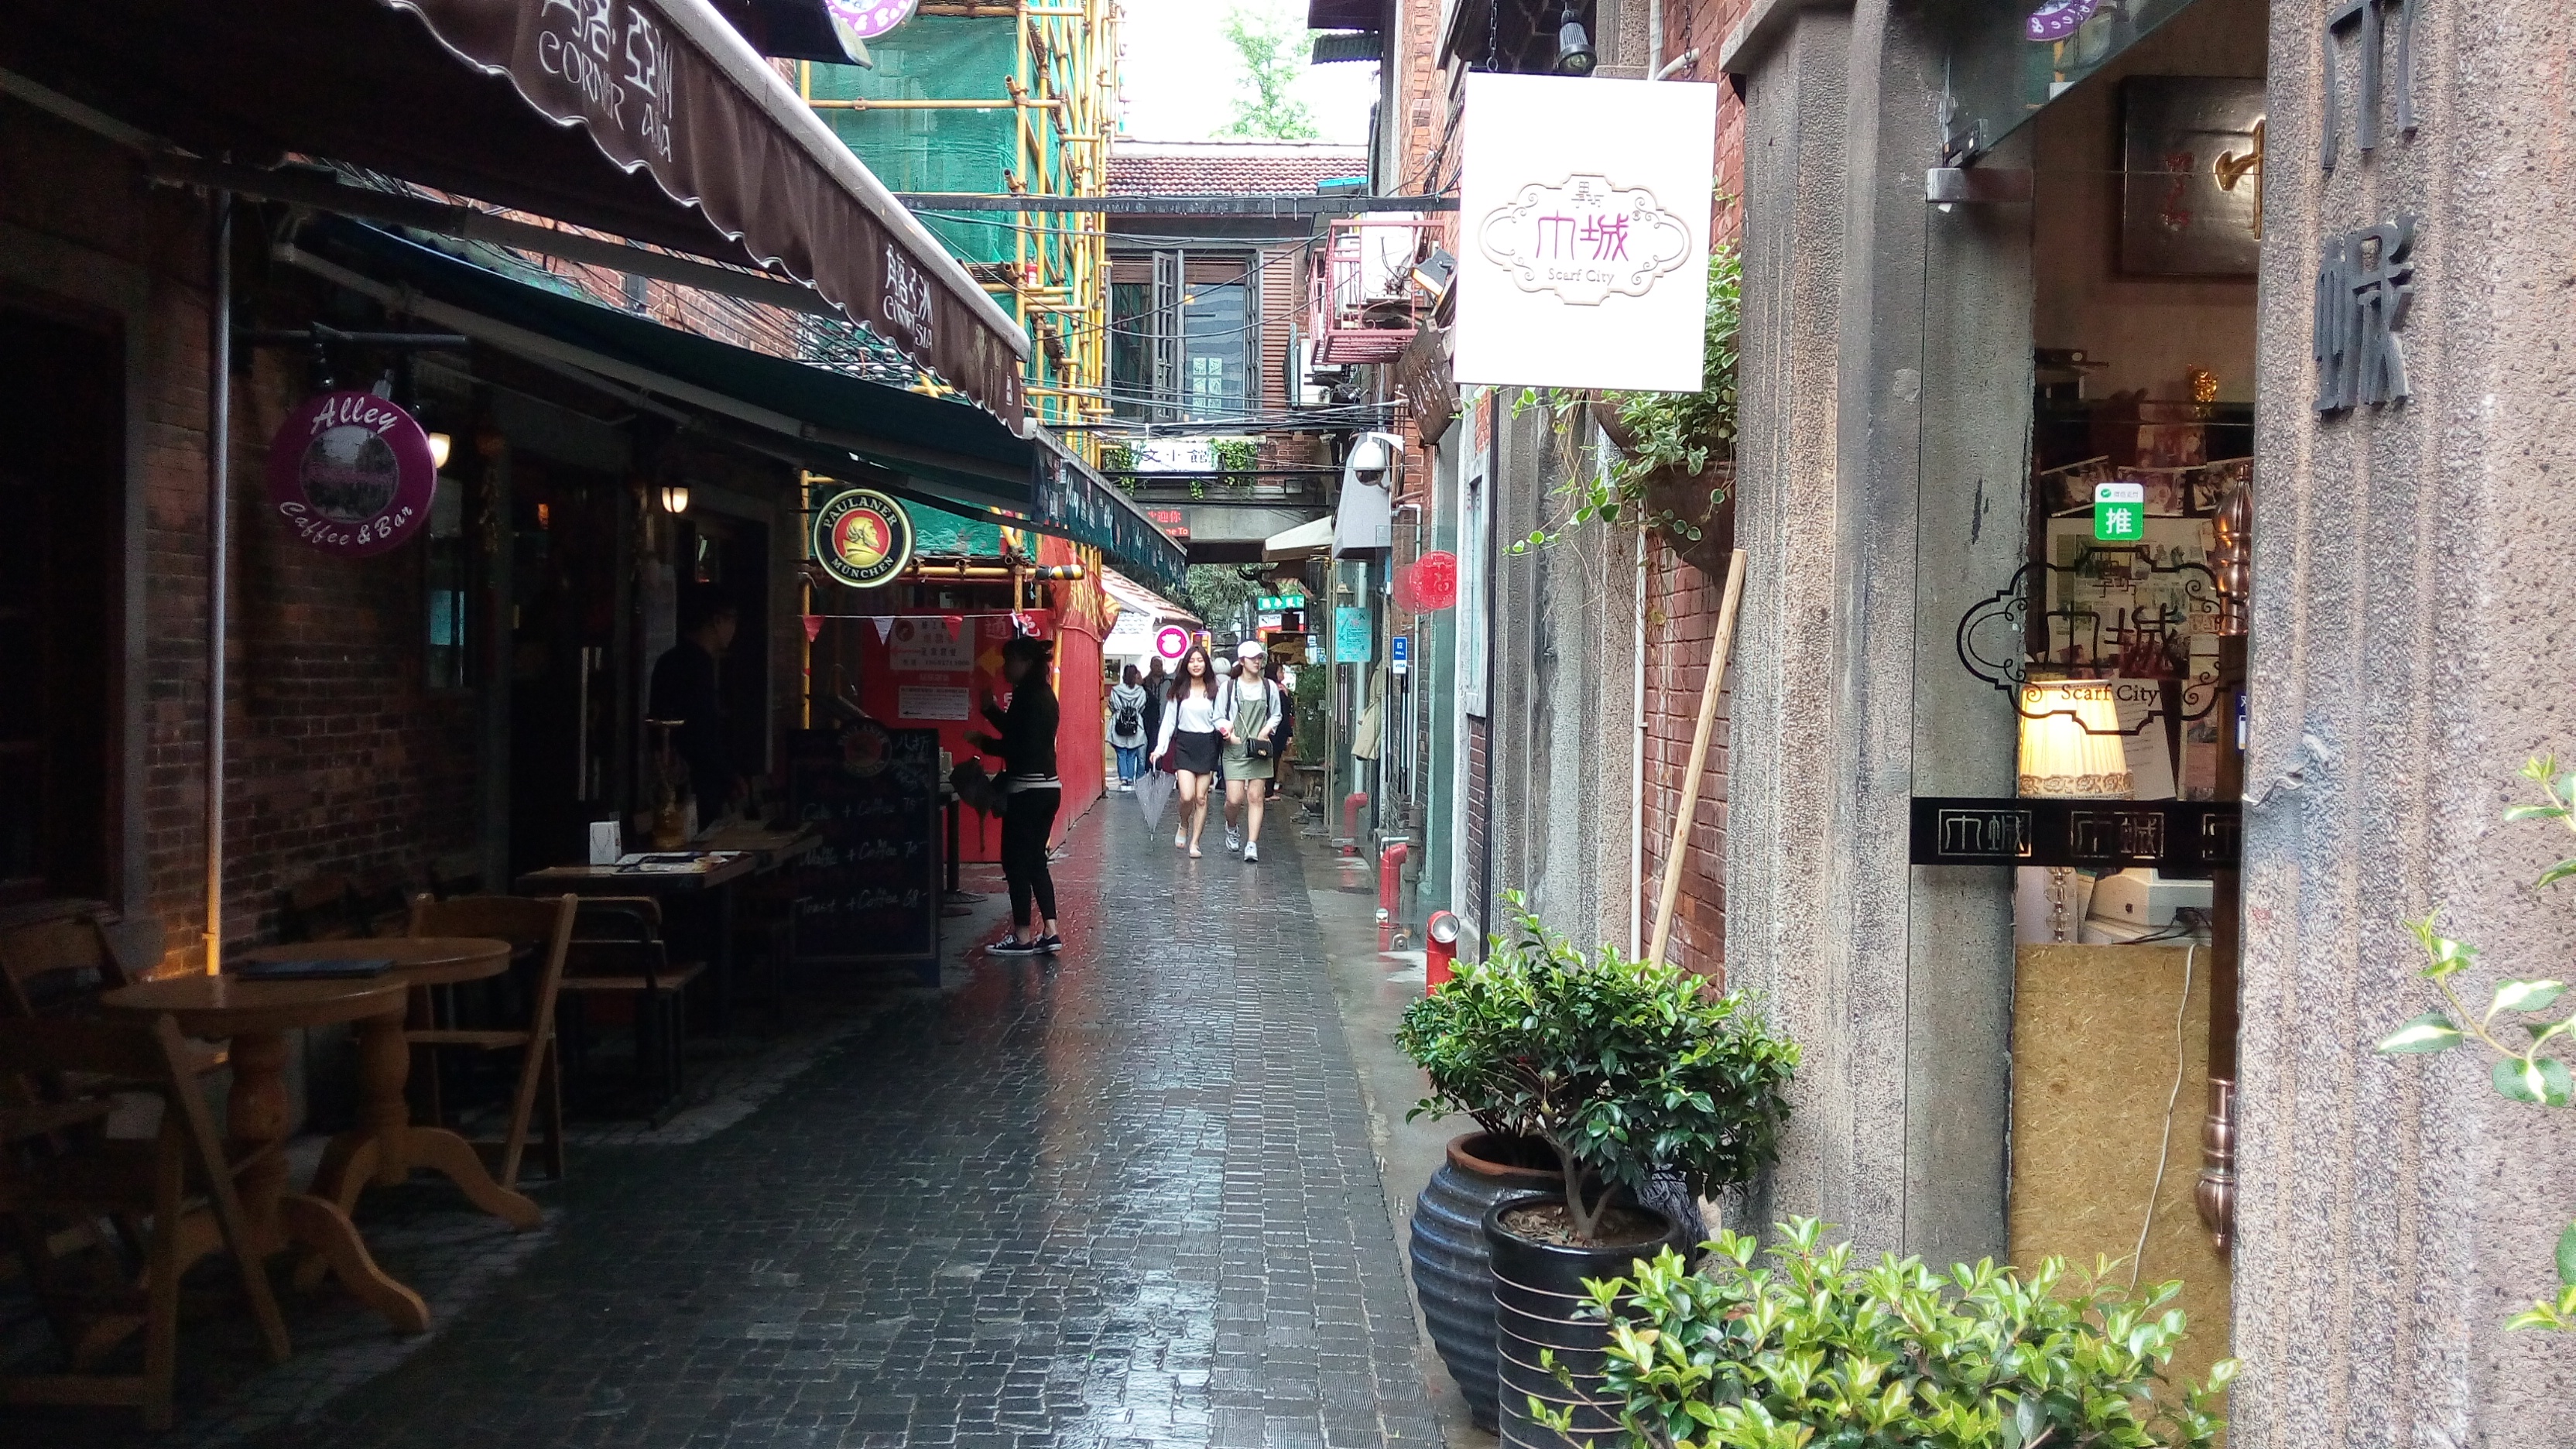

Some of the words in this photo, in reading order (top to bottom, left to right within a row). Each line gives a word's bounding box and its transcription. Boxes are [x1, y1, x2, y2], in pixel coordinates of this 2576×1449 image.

[539, 30, 625, 131] CORNR
[1547, 268, 1583, 281] Scarf
[1586, 269, 1615, 286] City
[310, 396, 398, 435] Alley
[357, 524, 371, 545] &
[375, 506, 413, 538] Bar
[823, 496, 898, 528] PAULANER
[2105, 507, 2132, 534] 推
[2060, 683, 2112, 701] Scarf
[2117, 684, 2160, 706] City
